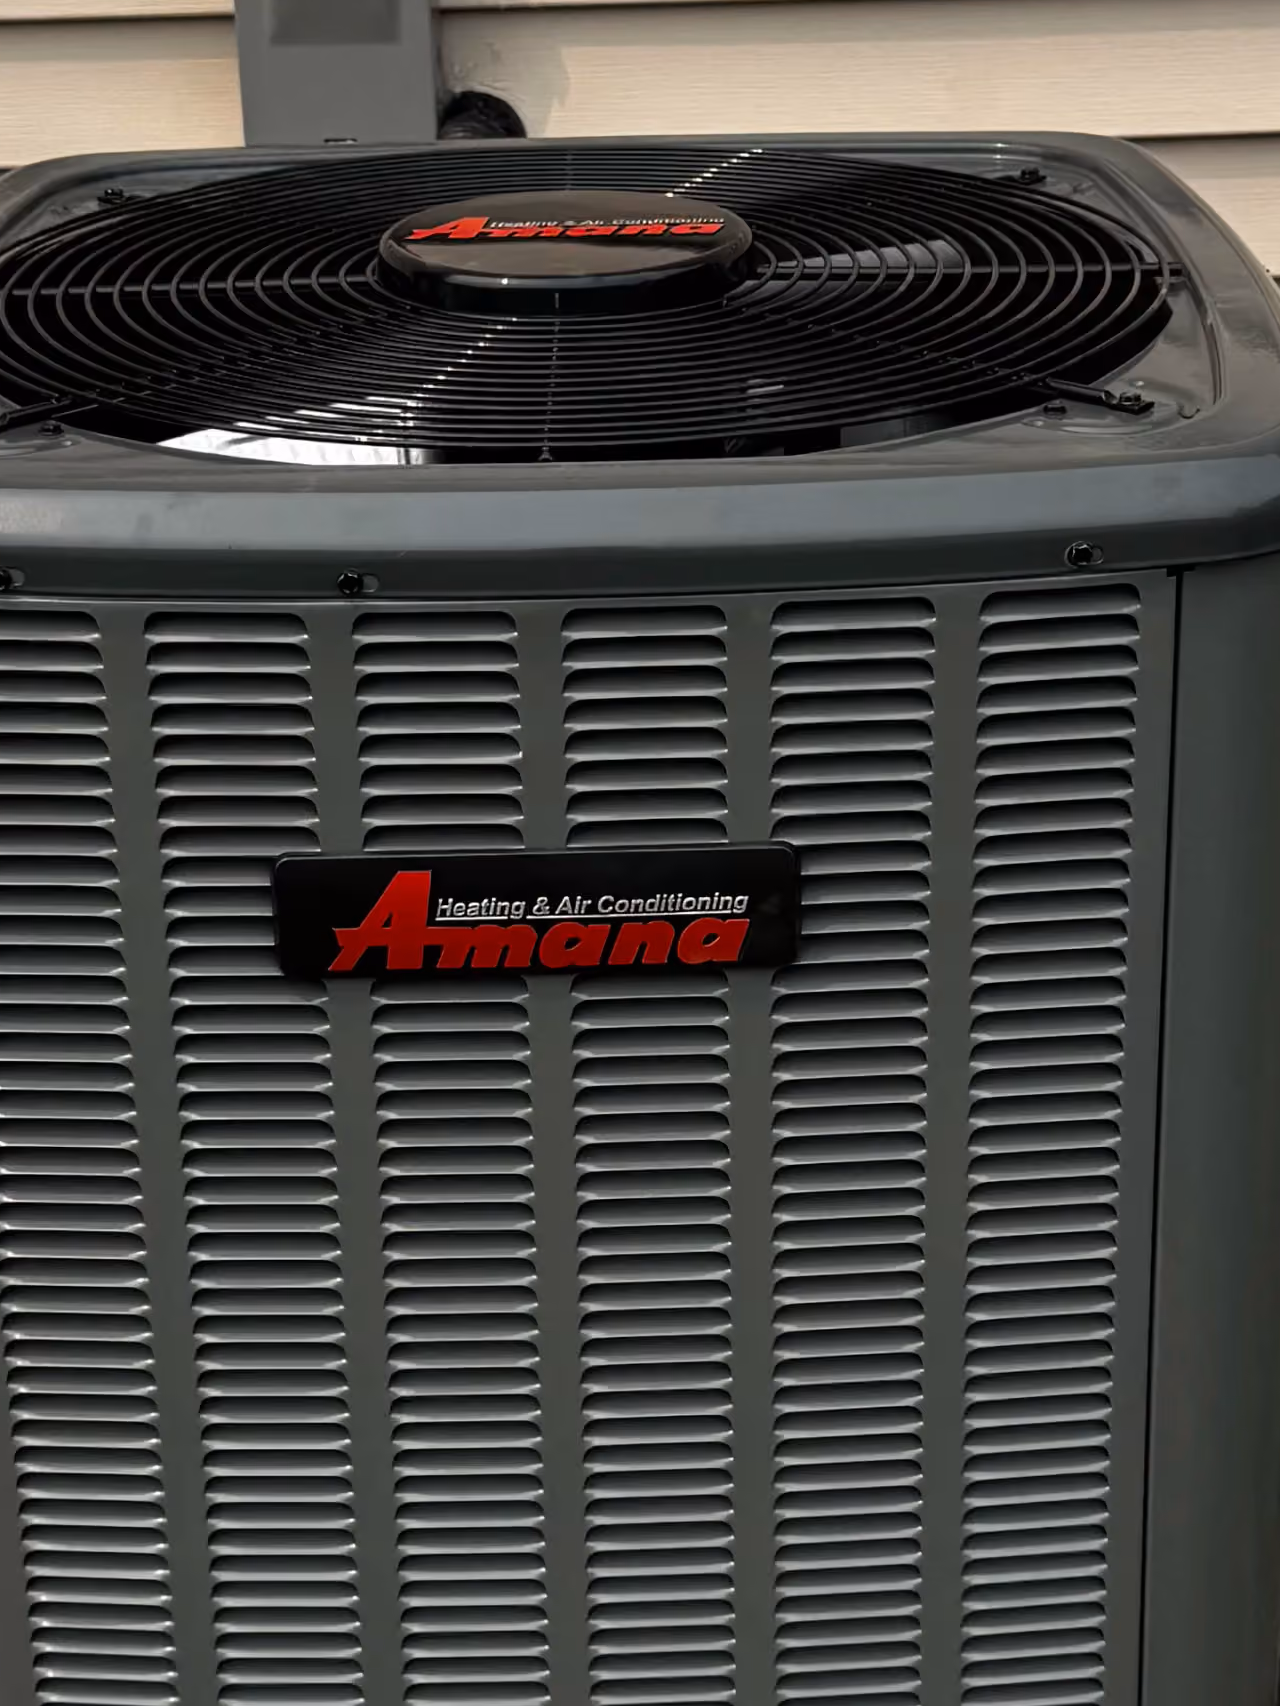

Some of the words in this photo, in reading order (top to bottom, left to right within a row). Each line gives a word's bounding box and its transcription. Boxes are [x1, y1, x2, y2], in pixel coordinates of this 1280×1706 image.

[406, 216, 725, 240] Amana
[436, 897, 526, 919] Heating
[532, 896, 550, 915] &
[555, 896, 592, 915] Air
[597, 892, 749, 914] Conditioning
[328, 870, 750, 971] Amana
